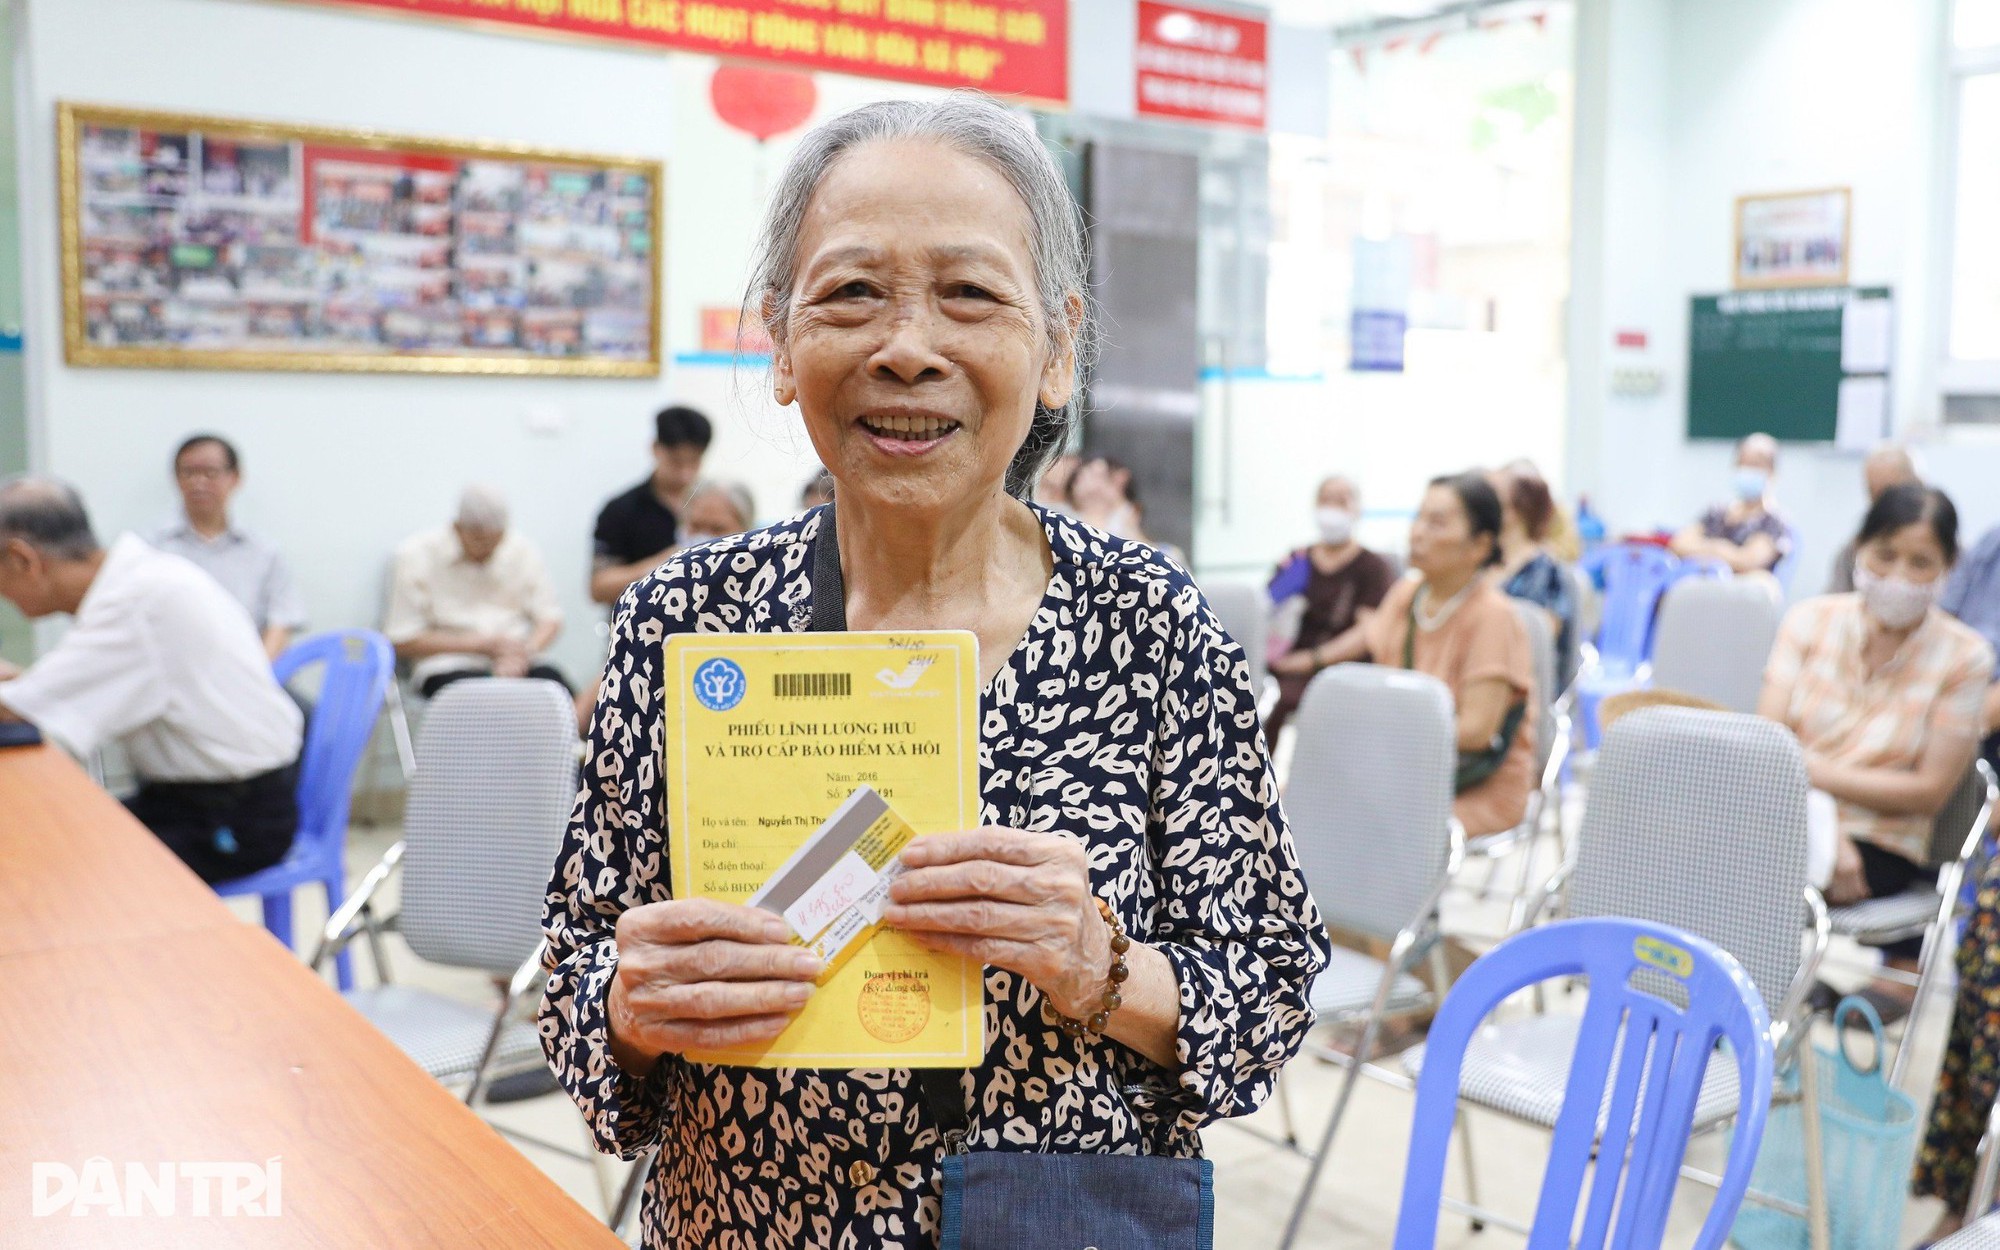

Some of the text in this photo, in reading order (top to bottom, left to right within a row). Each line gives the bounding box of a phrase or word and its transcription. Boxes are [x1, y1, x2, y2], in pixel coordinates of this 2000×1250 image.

[728, 718, 916, 736] PHIẾU LĨNH LƯƠNG HƯU
[705, 738, 941, 760] VÀ TRỢ CẤP BẢO HIỂM XÃ HỘI
[856, 772, 878, 781] 2016
[702, 816, 716, 828] Họ
[718, 816, 731, 827] và
[758, 815, 792, 828] Nguyễn
[794, 816, 808, 827] Thị
[702, 838, 719, 849] Địa
[703, 860, 716, 871] Số
[717, 861, 738, 872] điện
